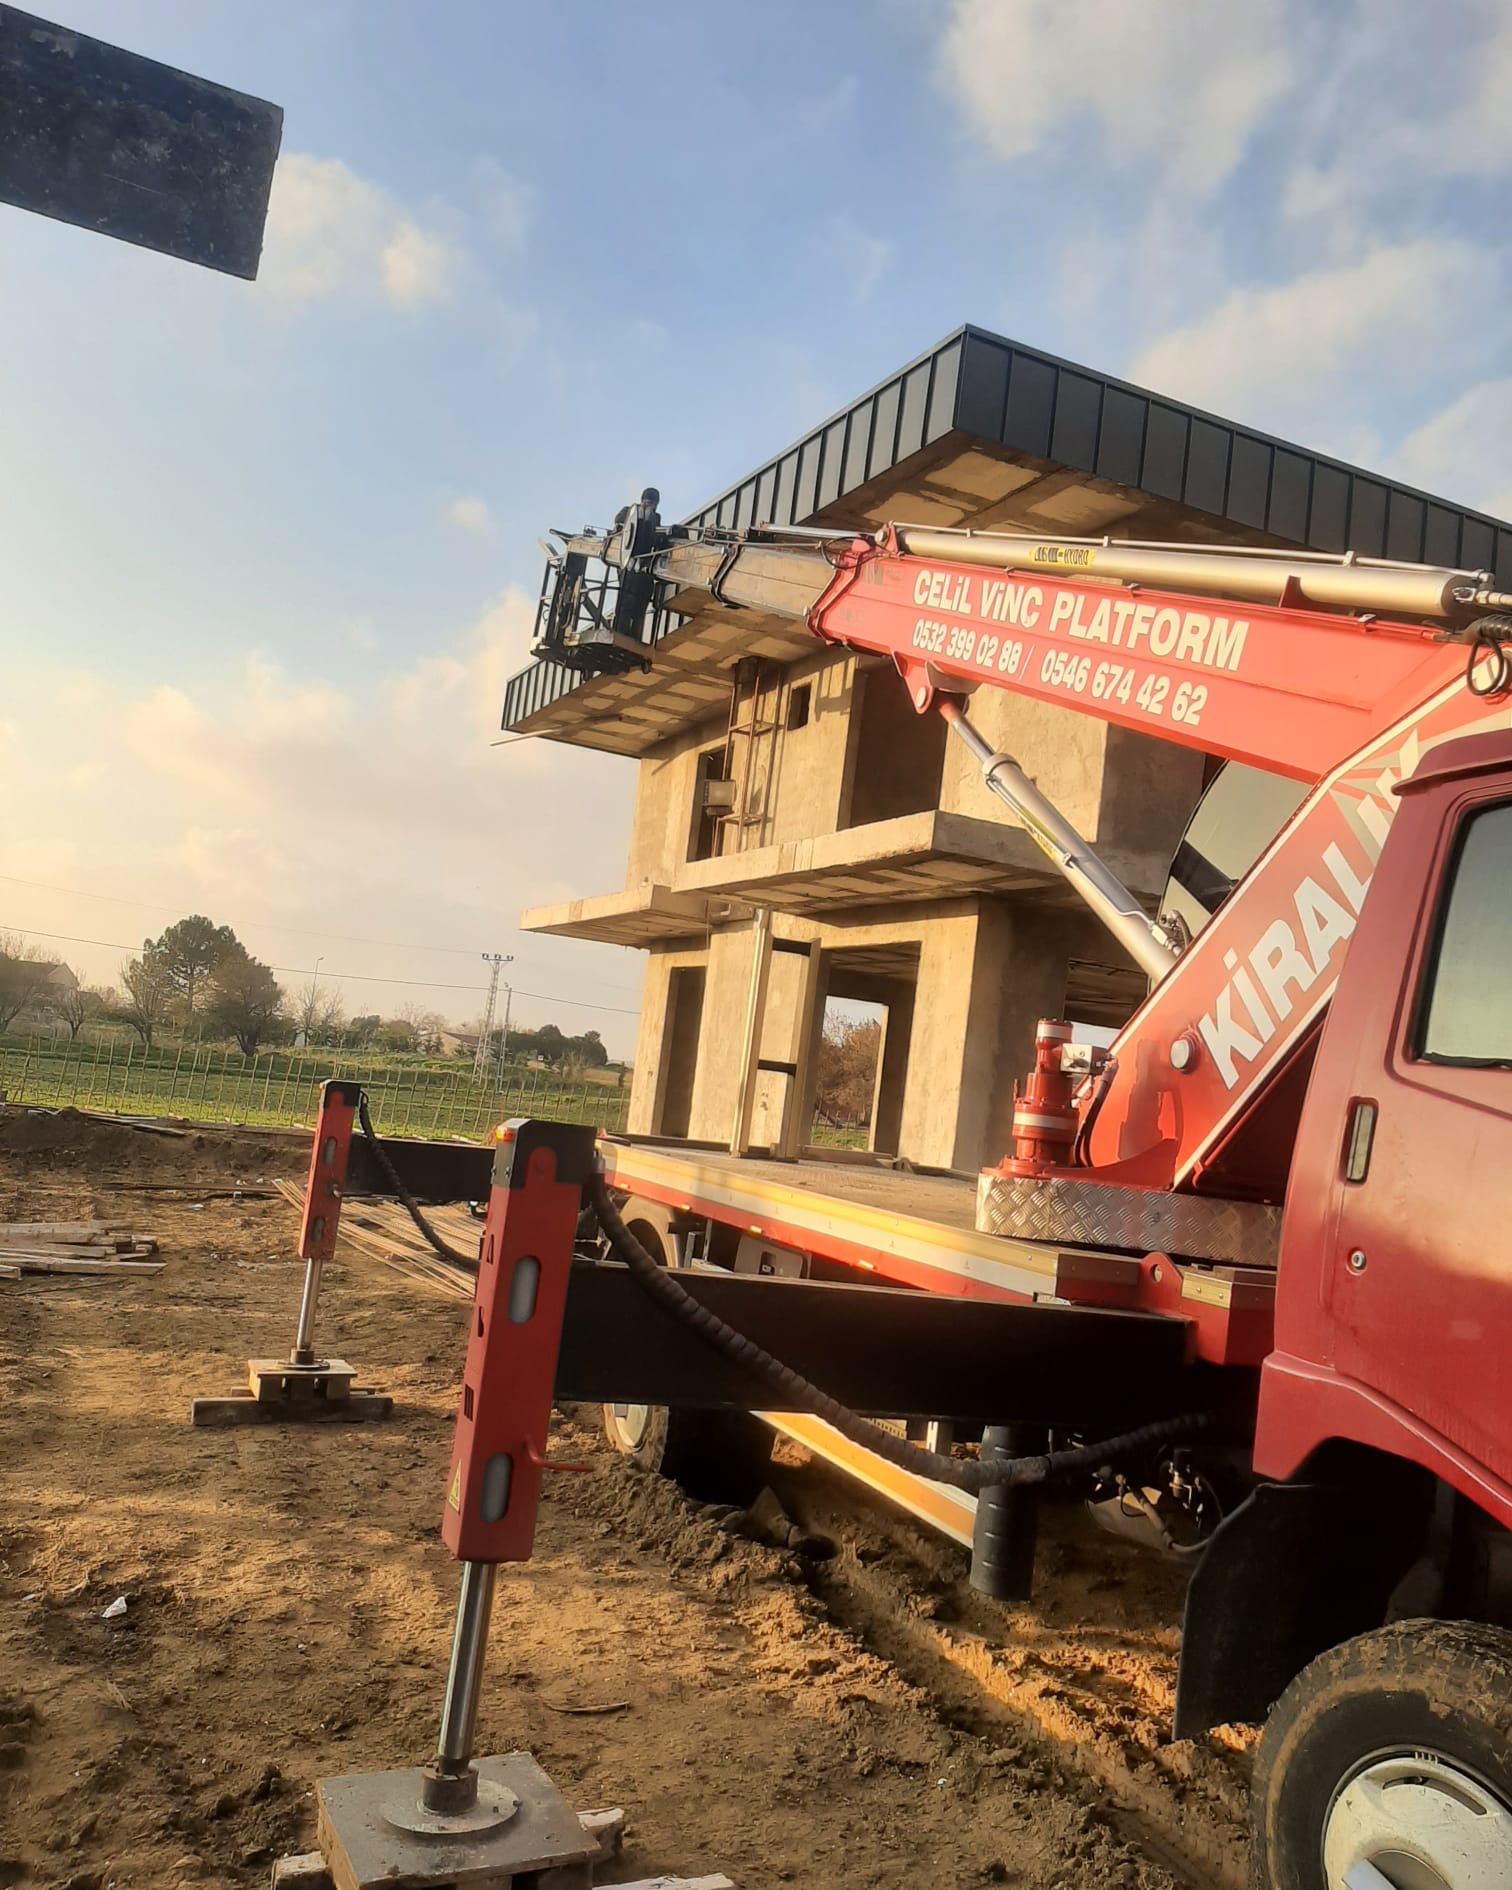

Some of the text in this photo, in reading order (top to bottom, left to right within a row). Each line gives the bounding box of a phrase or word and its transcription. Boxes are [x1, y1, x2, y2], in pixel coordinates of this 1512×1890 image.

[912, 618, 947, 653] 0532
[946, 626, 976, 661] 399
[975, 633, 999, 668] 02
[998, 640, 1022, 674] 88
[1040, 649, 1092, 693] 0546
[1091, 661, 1136, 705] 674
[1135, 673, 1171, 715] 42
[1171, 681, 1208, 726] 62
[1048, 591, 1250, 672] PLATFORM
